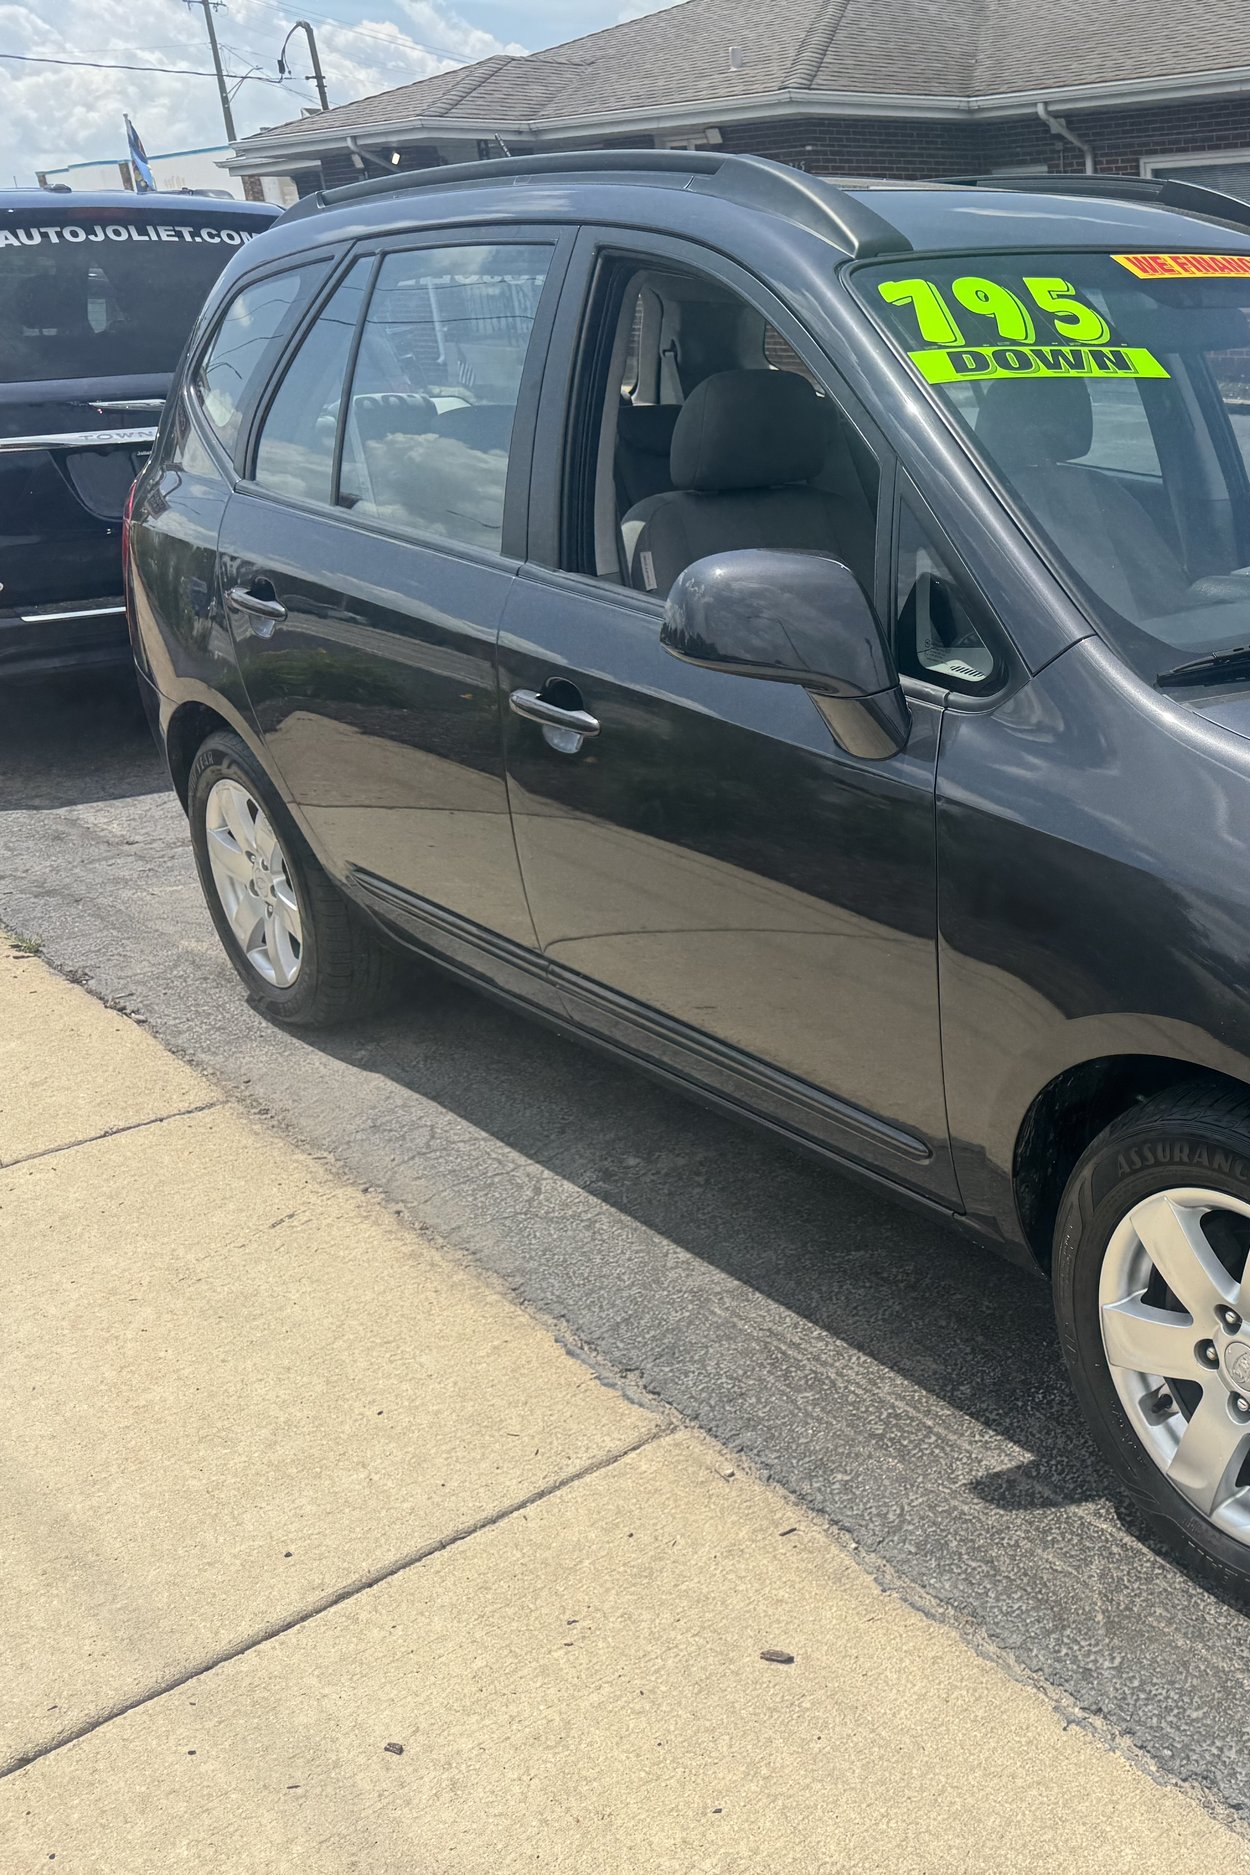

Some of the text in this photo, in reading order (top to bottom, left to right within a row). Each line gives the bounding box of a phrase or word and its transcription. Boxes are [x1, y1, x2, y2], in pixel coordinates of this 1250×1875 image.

[1123, 256, 1182, 275] WE
[877, 276, 1110, 346] 795
[946, 349, 1140, 376] DOWN
[79, 431, 153, 441] TOWN
